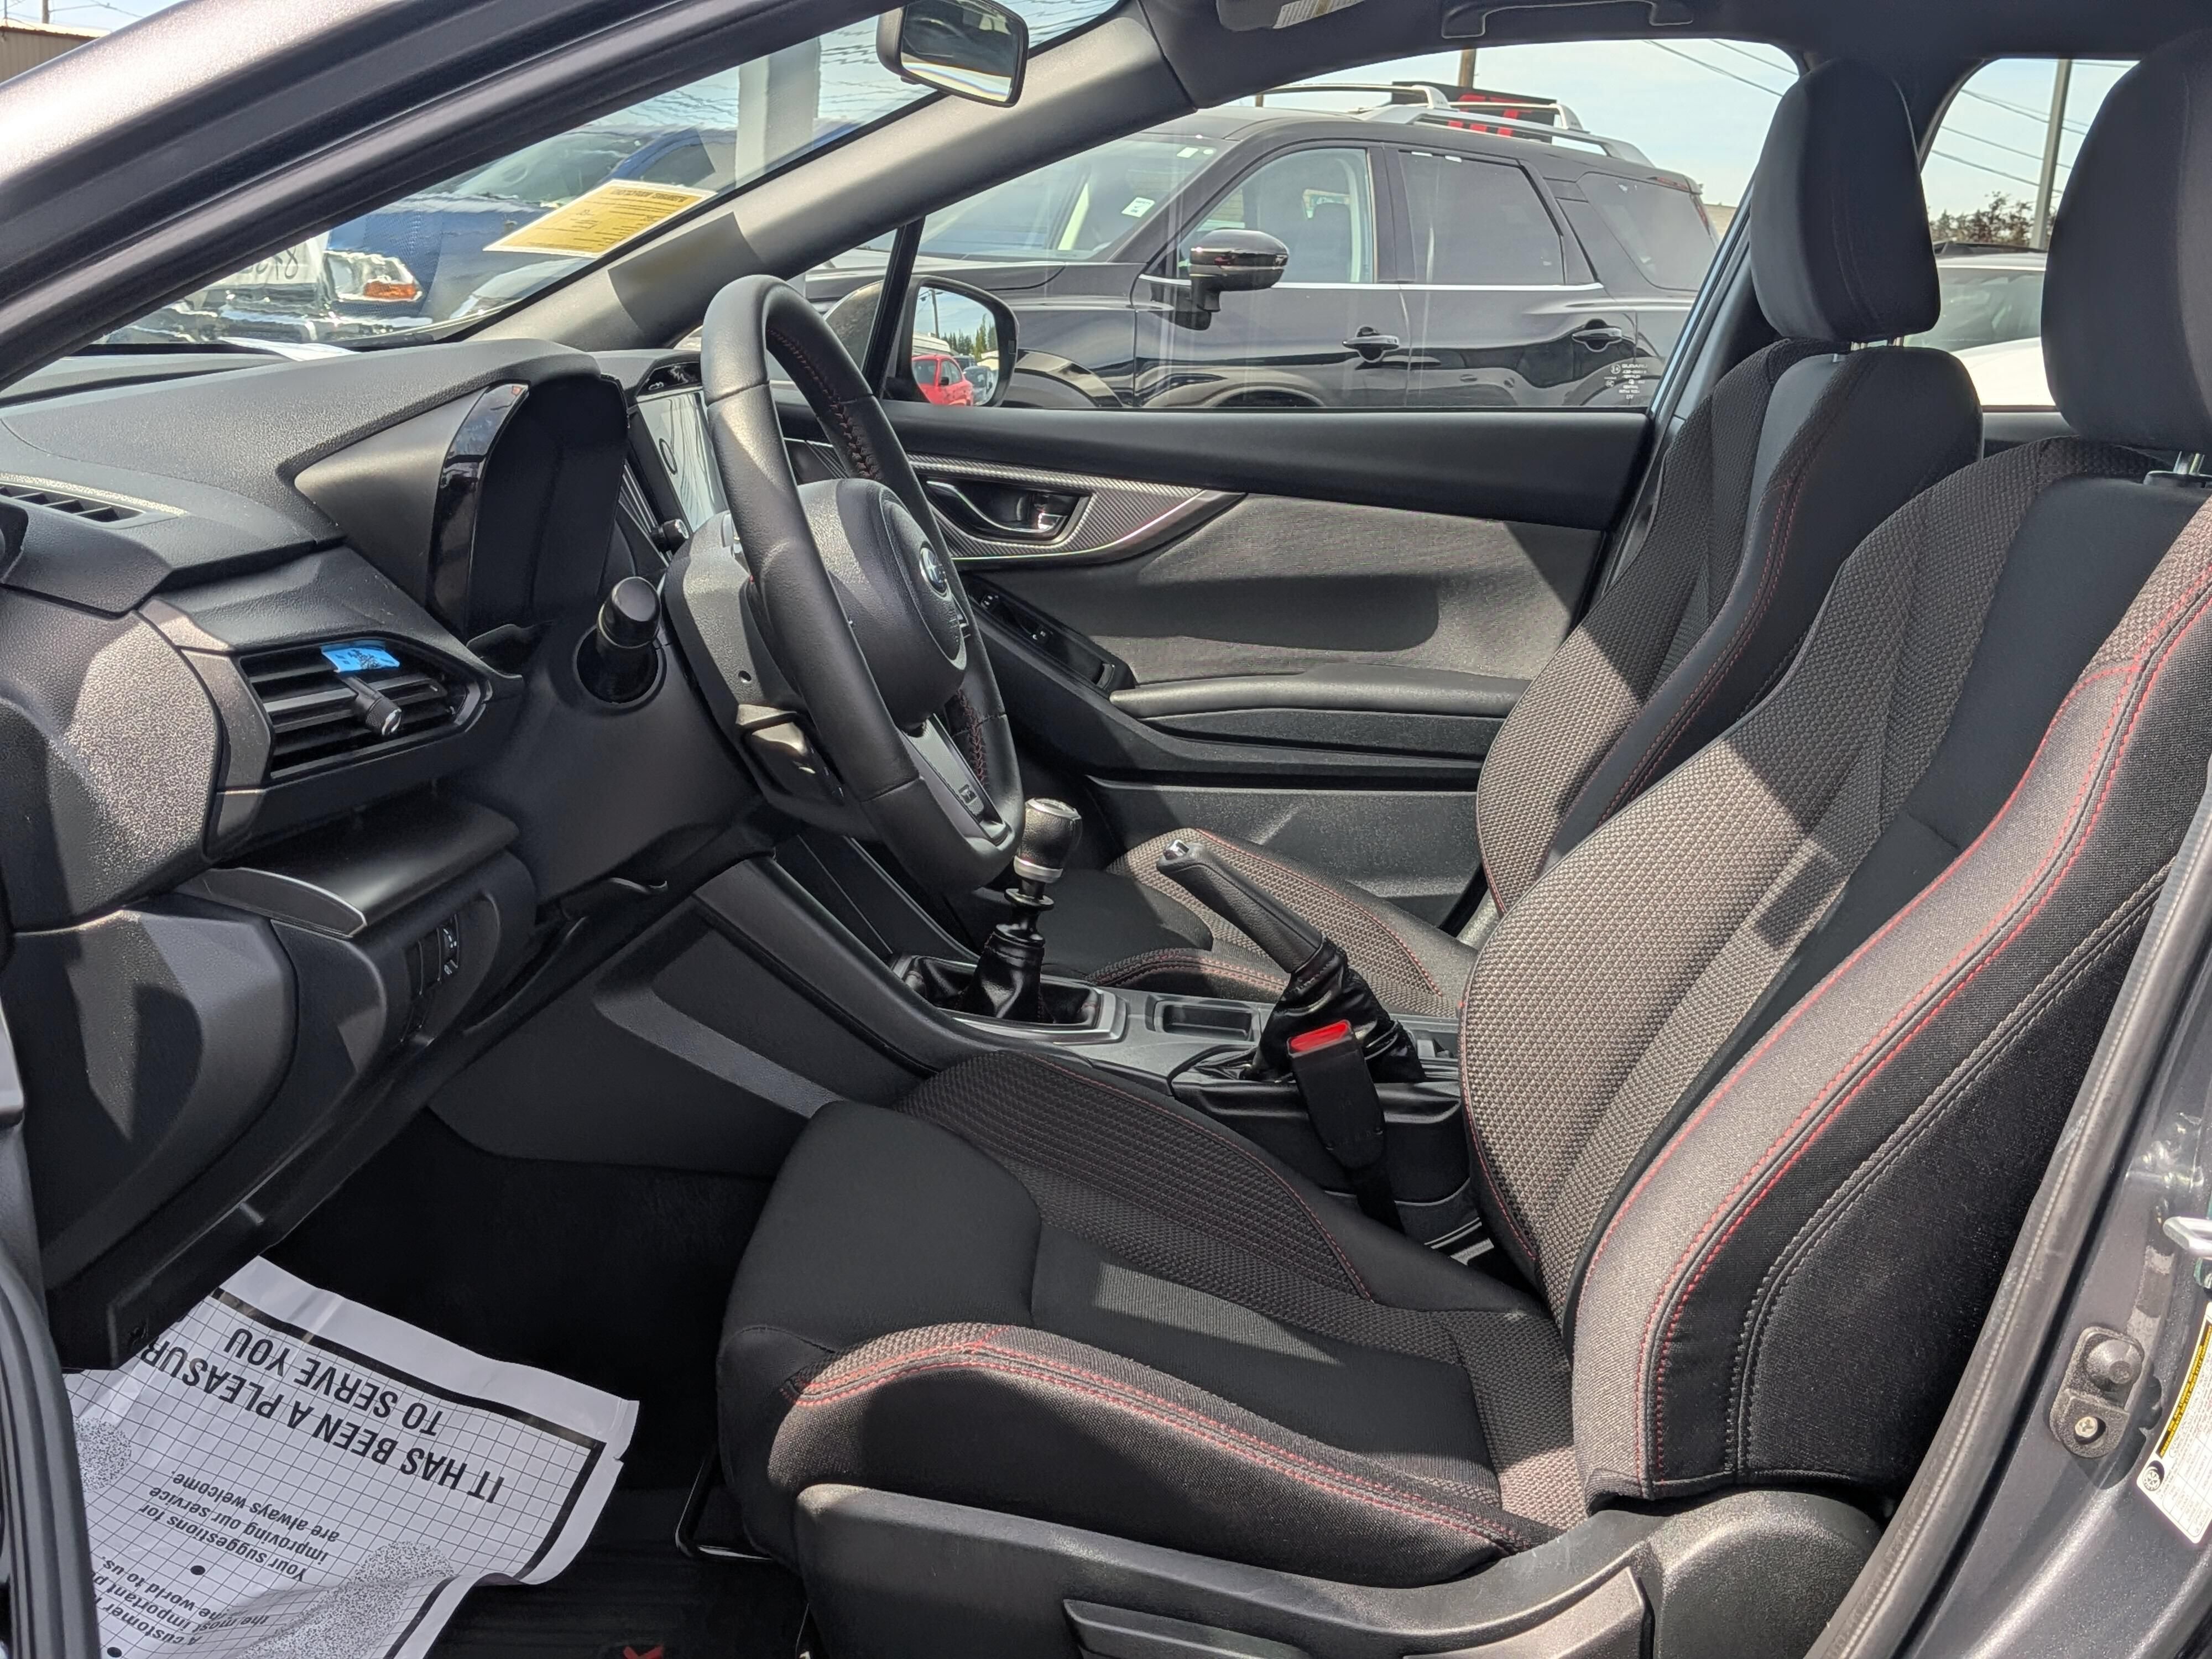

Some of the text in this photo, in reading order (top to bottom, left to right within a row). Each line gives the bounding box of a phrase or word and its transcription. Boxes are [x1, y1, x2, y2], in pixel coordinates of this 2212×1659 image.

[223, 1328, 444, 1437] TO SERVE YOU
[140, 1335, 505, 1504] IT HAS BEEN A PLEASUR
[149, 1487, 329, 1566] improving our service
[171, 1470, 340, 1542] are always welcome.
[138, 1504, 306, 1582] Your suggestions for
[101, 1556, 125, 1575] us.
[127, 1573, 146, 1588] to
[106, 1583, 191, 1631] important
[145, 1583, 196, 1612] world
[103, 1604, 202, 1645] A customer
[191, 1618, 237, 1633] most
[240, 1615, 270, 1625] the
